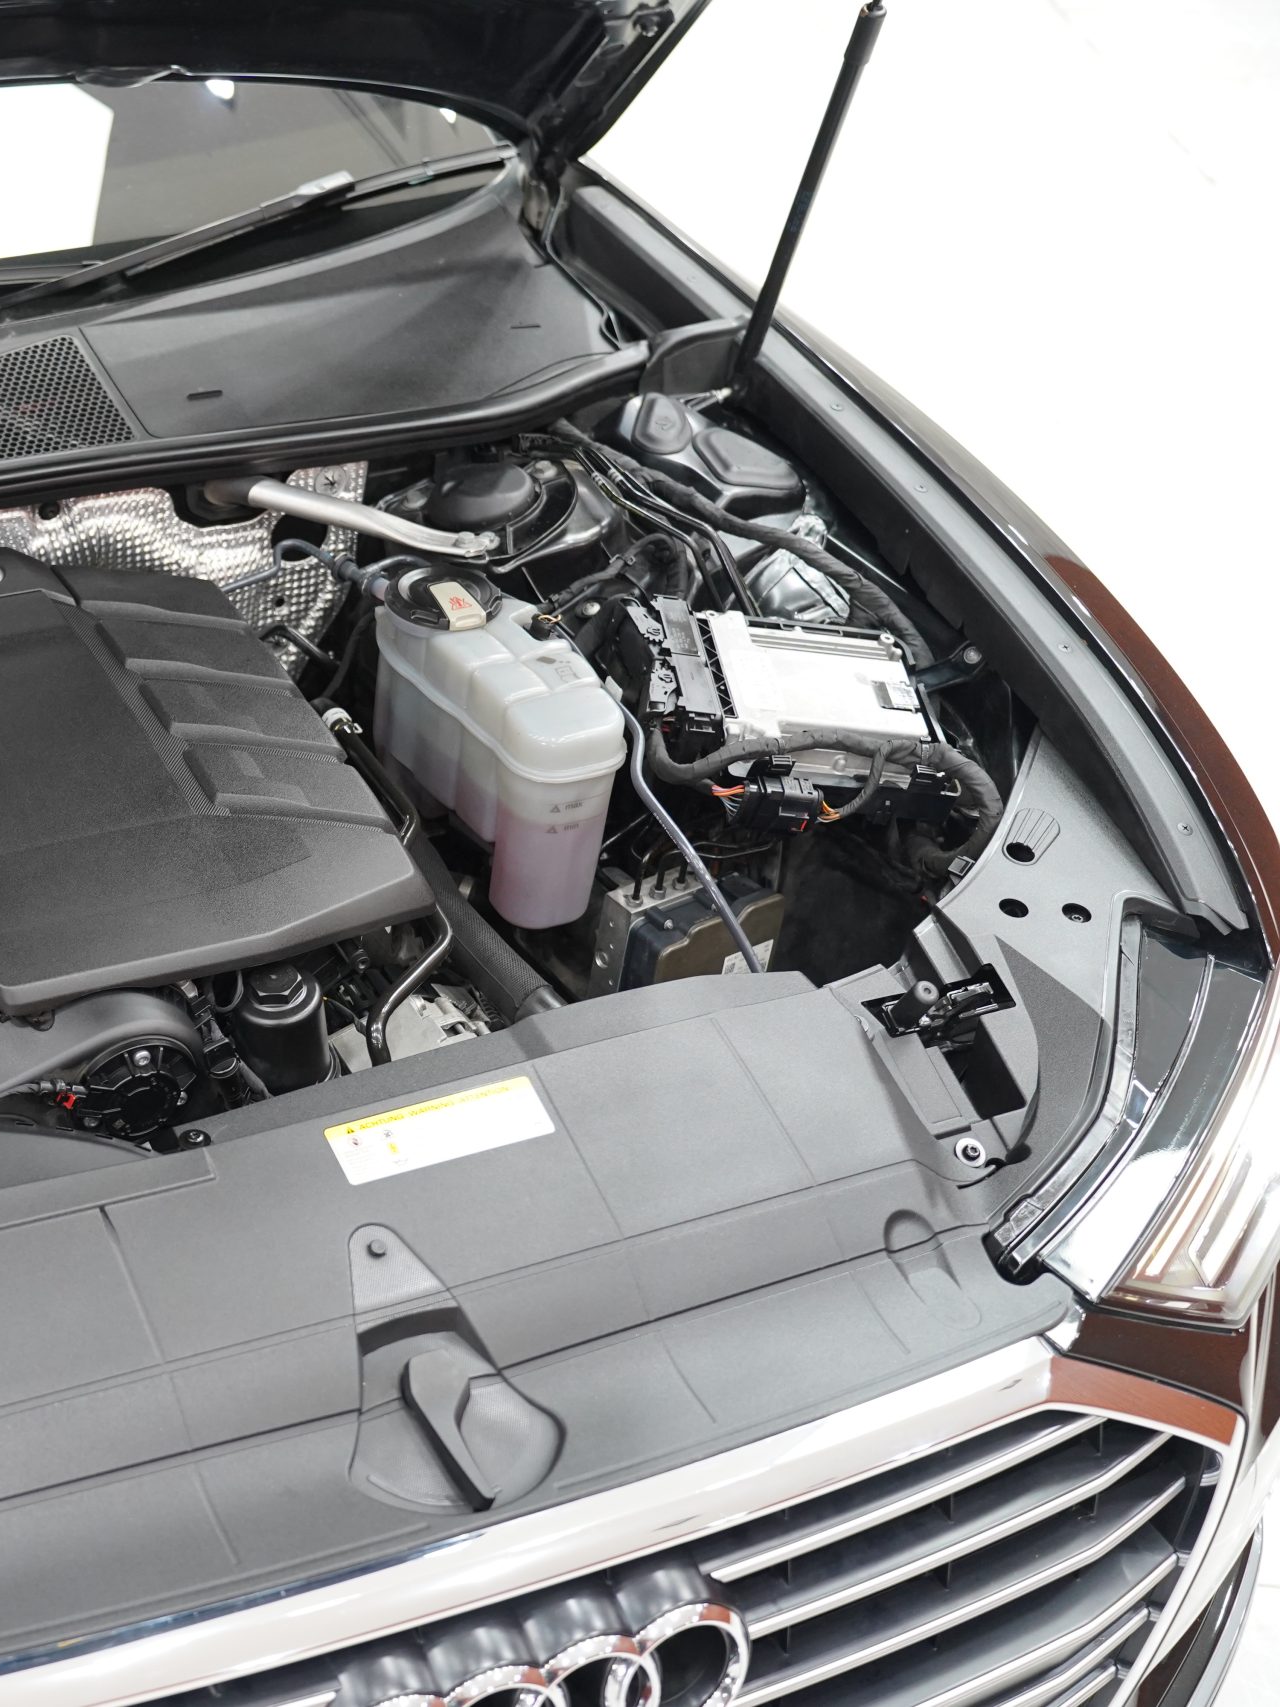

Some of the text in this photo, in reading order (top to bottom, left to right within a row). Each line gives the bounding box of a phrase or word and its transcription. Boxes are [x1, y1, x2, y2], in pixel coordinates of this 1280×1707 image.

[565, 802, 583, 811] max
[359, 1114, 405, 1130] ACHTUNG
[408, 1101, 454, 1116] WARNING
